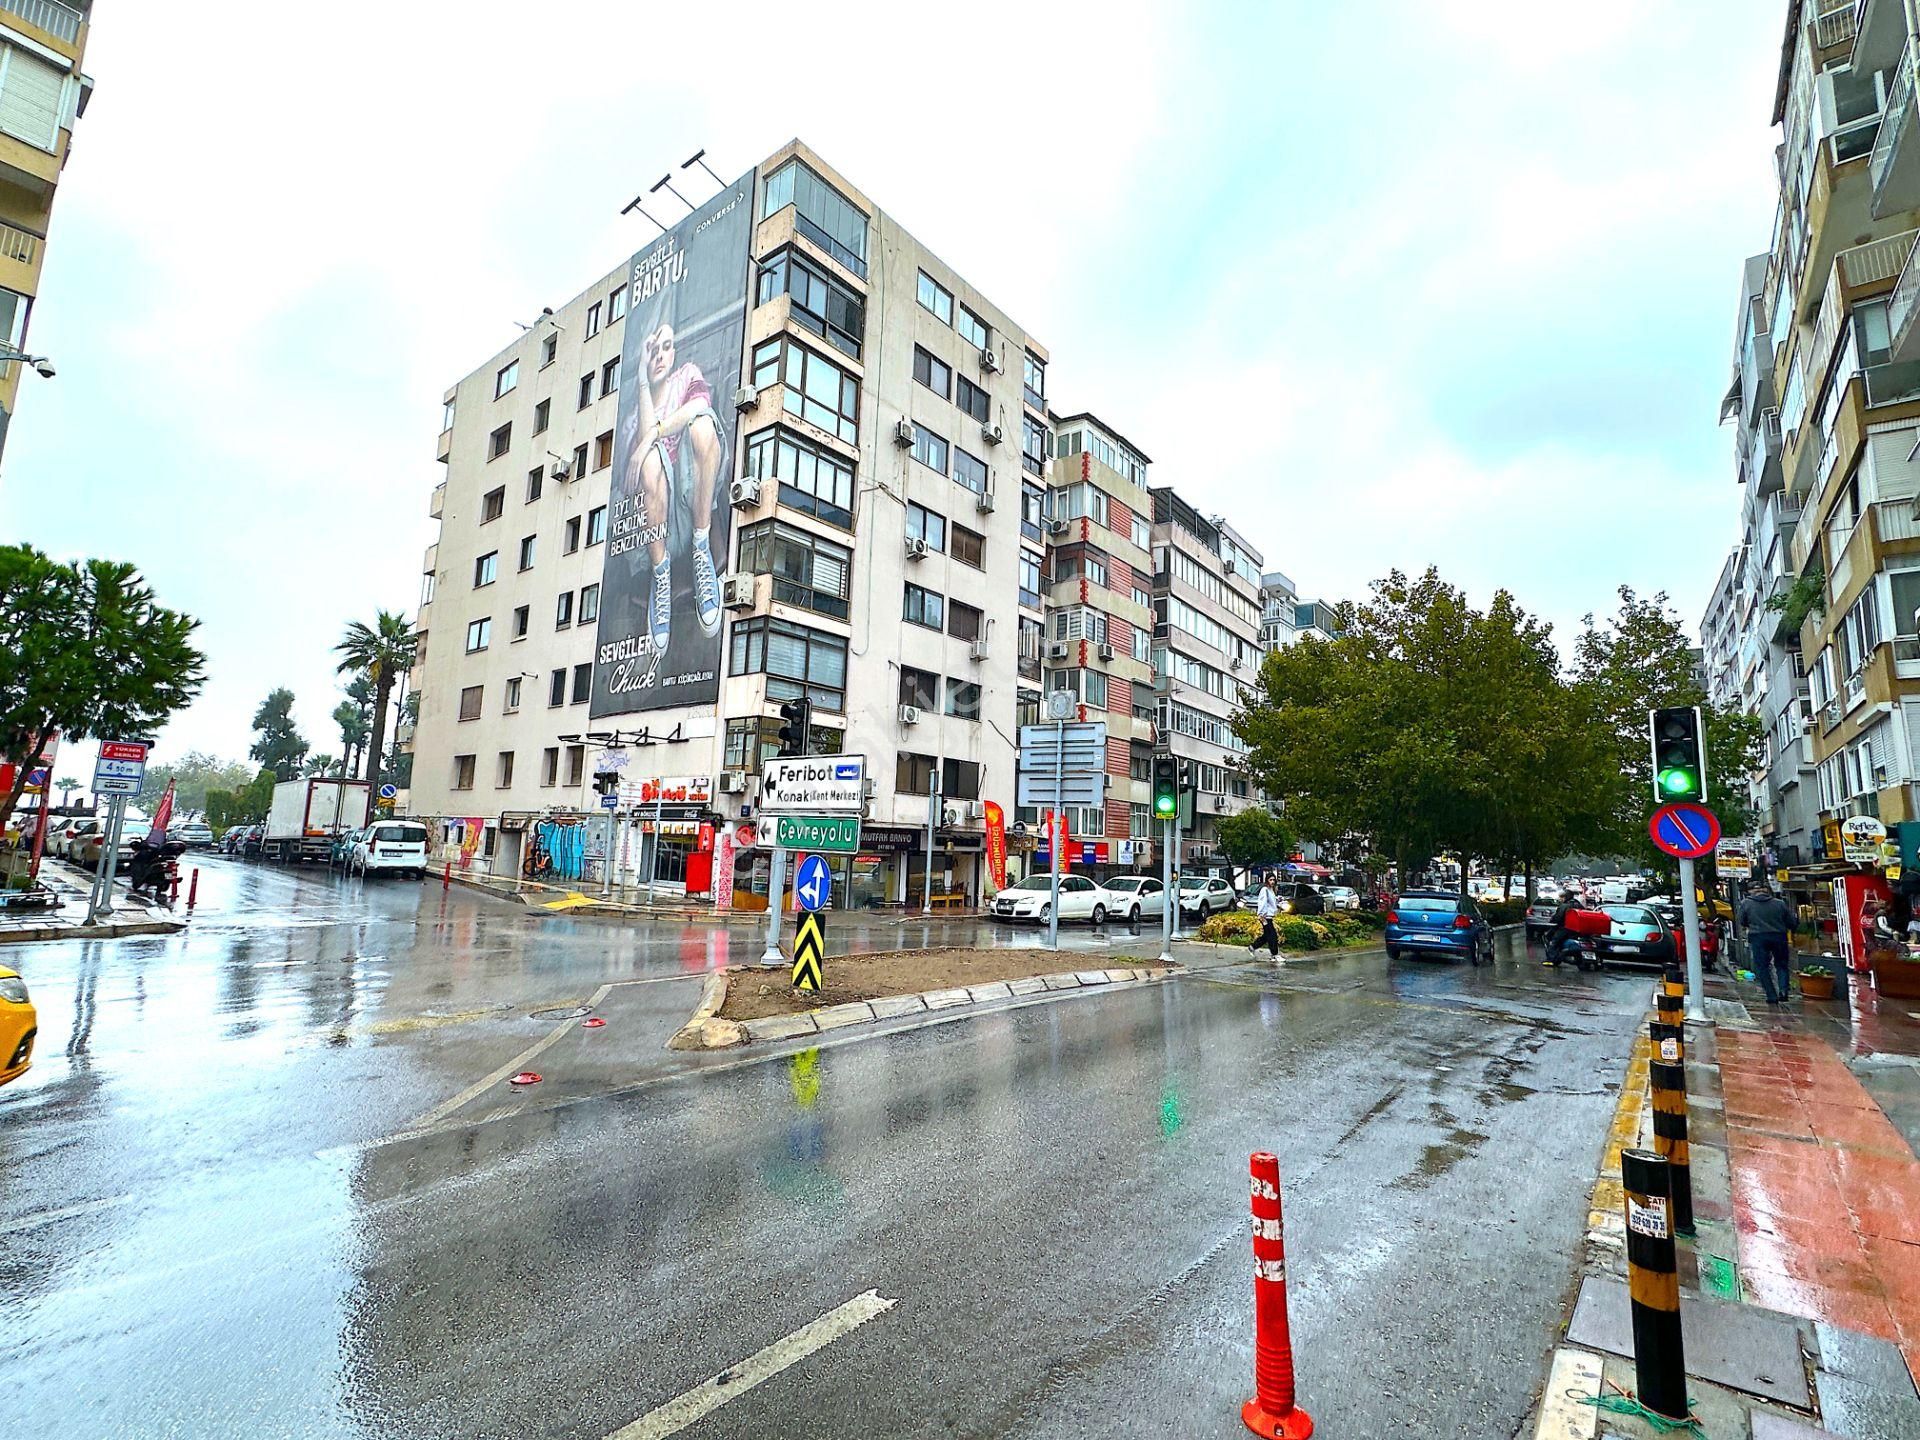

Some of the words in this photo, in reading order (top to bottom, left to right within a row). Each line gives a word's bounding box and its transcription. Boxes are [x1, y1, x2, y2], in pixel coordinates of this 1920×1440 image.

[695, 200, 737, 234] CONVERSE
[630, 248, 688, 309] BARTU,
[613, 497, 629, 519] İYİ
[632, 490, 646, 513] Kİ
[612, 509, 649, 537] KENDİNE
[608, 652, 662, 695] Chuck
[779, 765, 833, 782] Feribot
[778, 818, 853, 847] Çevreyolu
[1848, 822, 1879, 832] Reflex
